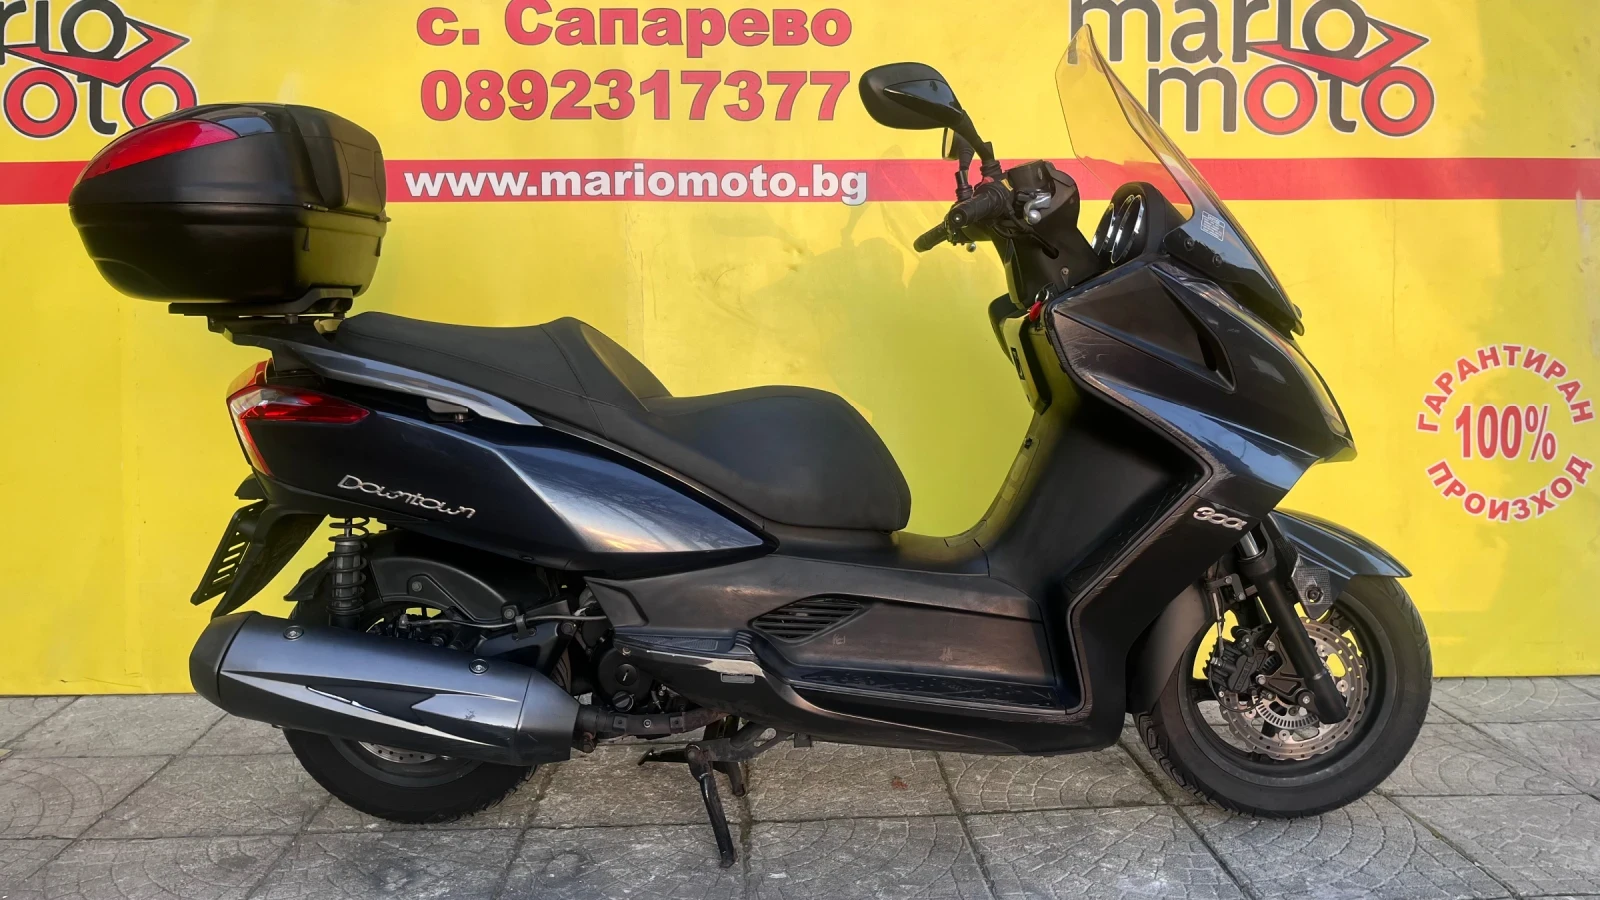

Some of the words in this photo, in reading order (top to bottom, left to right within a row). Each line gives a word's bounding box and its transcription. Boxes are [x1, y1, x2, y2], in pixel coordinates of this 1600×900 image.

[416, 7, 479, 46] с.
[504, 0, 853, 59] Сапарево
[1068, 0, 1368, 64] mario
[420, 69, 851, 122] 0892317377
[1147, 65, 1435, 137] moto
[403, 163, 868, 207] www.mariomoto.bg
[1417, 344, 1594, 433] ГАРАНТИРАН
[1455, 405, 1557, 461] 100%
[337, 474, 476, 519] Downtown
[1427, 455, 1594, 521] ПРОИЗХОД
